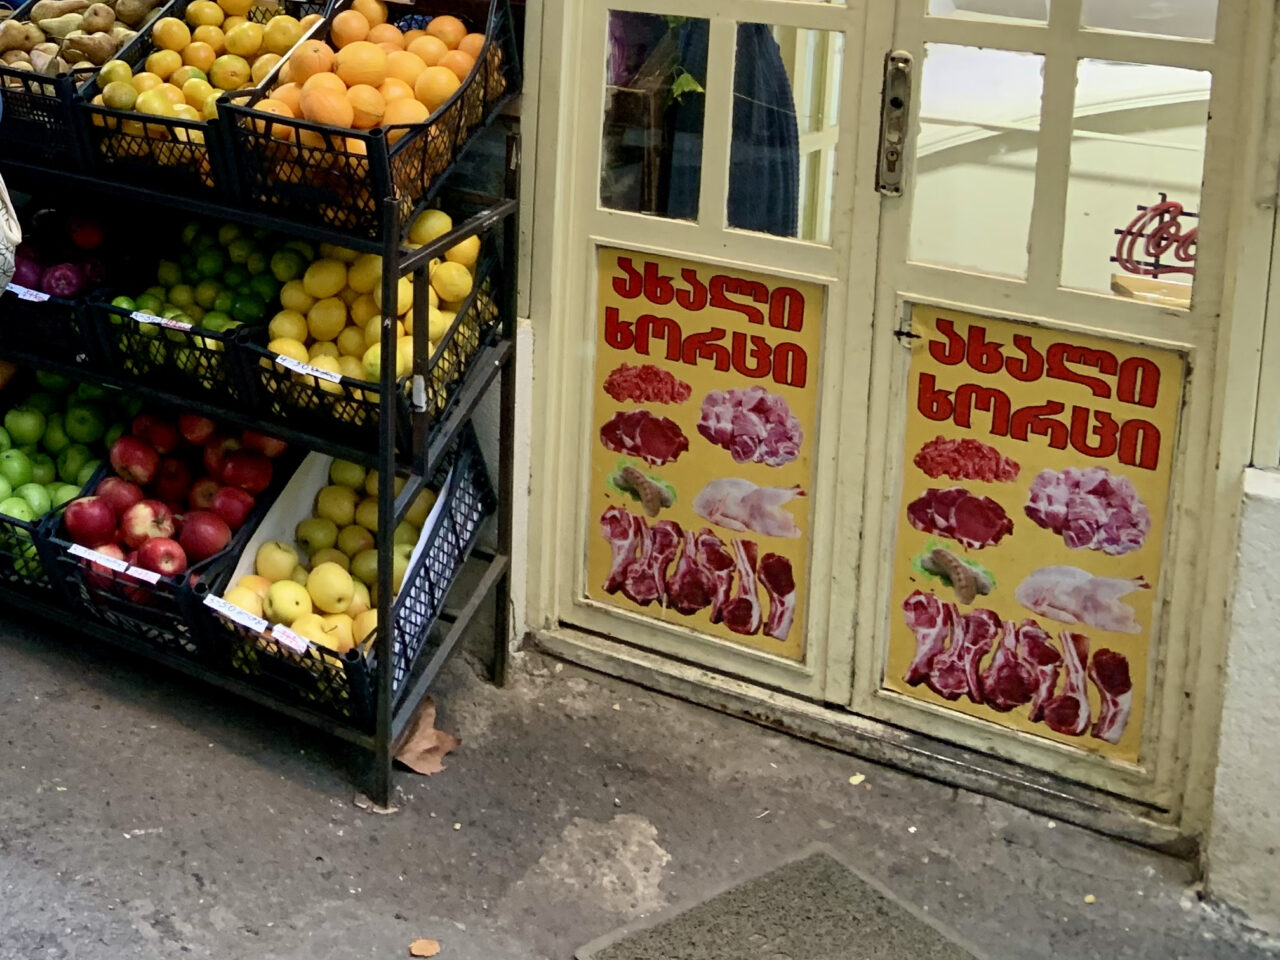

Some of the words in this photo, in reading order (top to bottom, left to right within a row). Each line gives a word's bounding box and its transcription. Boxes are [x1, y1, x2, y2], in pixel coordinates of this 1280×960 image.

[612, 256, 805, 332] ახალი
[604, 306, 808, 388] ხორცი
[928, 318, 1161, 408] ახალი
[917, 372, 1162, 471] ხორცი
